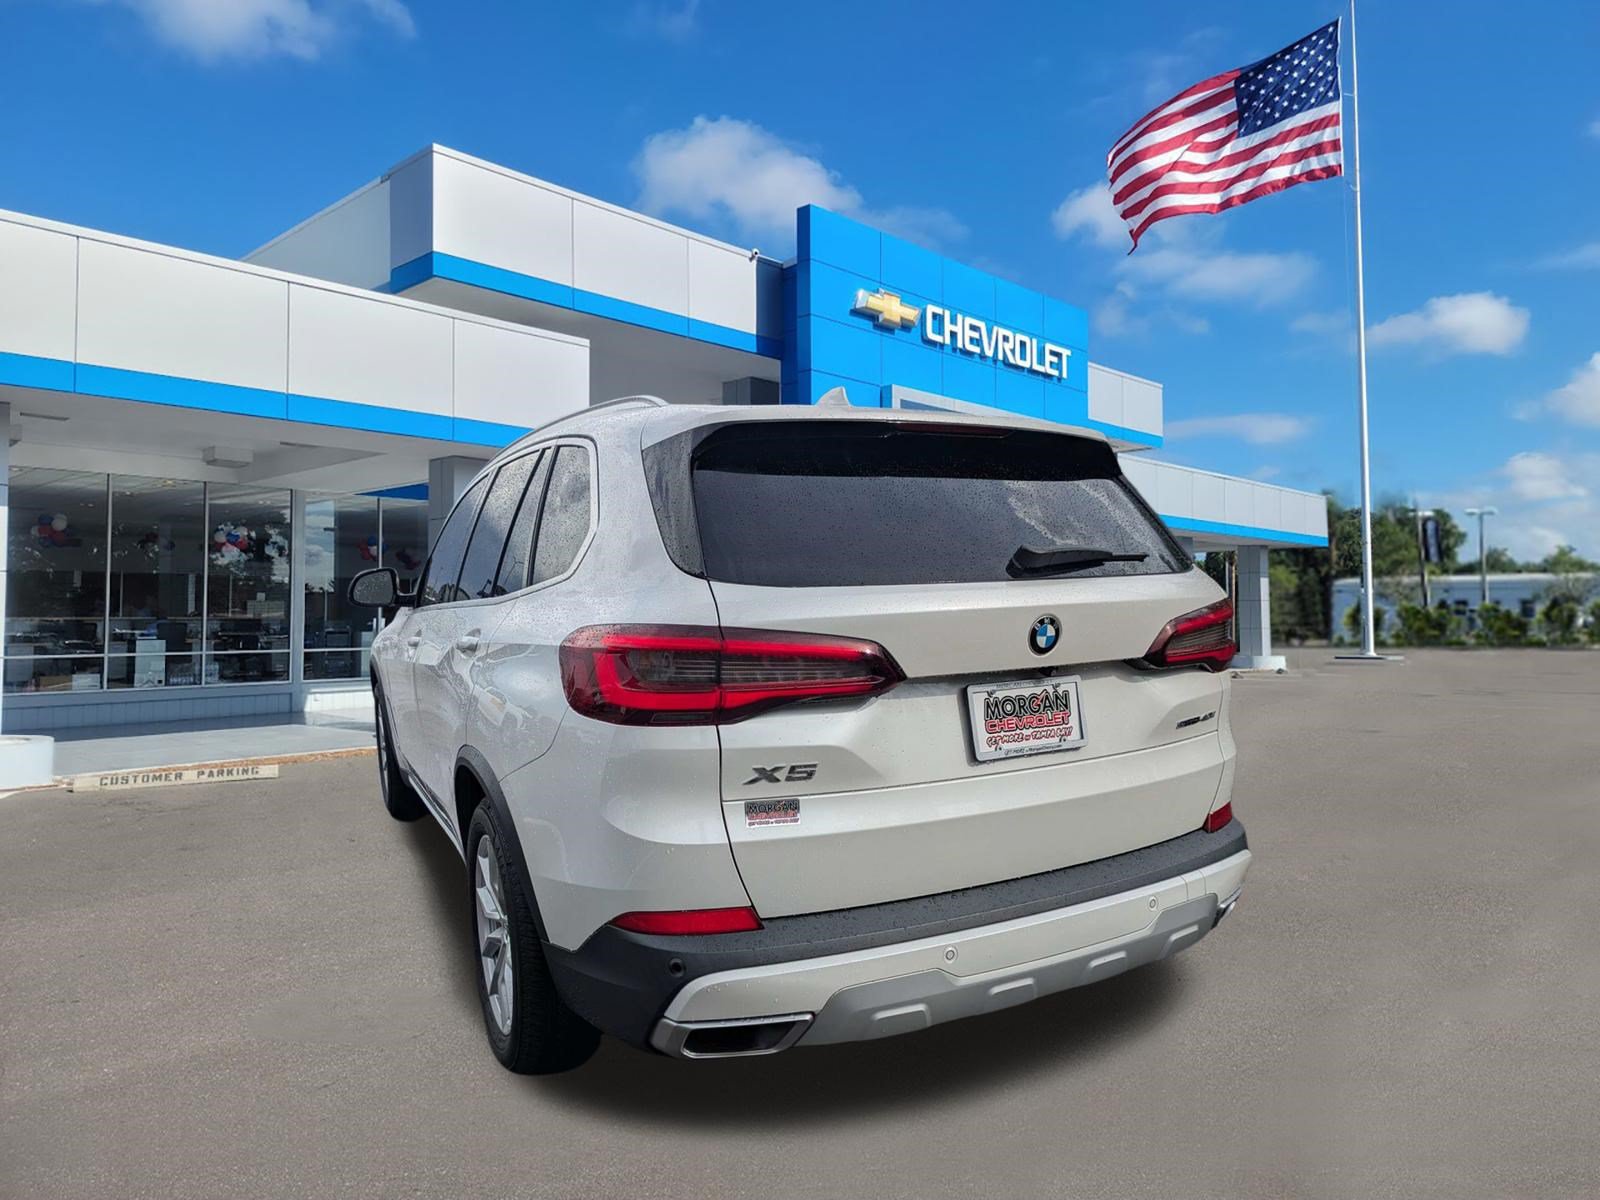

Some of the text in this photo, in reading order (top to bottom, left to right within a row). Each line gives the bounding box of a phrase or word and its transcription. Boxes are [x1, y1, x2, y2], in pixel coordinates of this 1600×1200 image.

[925, 304, 1072, 379] CHEVROLET
[984, 688, 1070, 720] MORGAN
[985, 711, 1071, 734] CHEVROLET
[100, 766, 259, 786] CUSTOMER PARKING
[742, 763, 818, 786] X5
[748, 800, 798, 815] MORGAN
